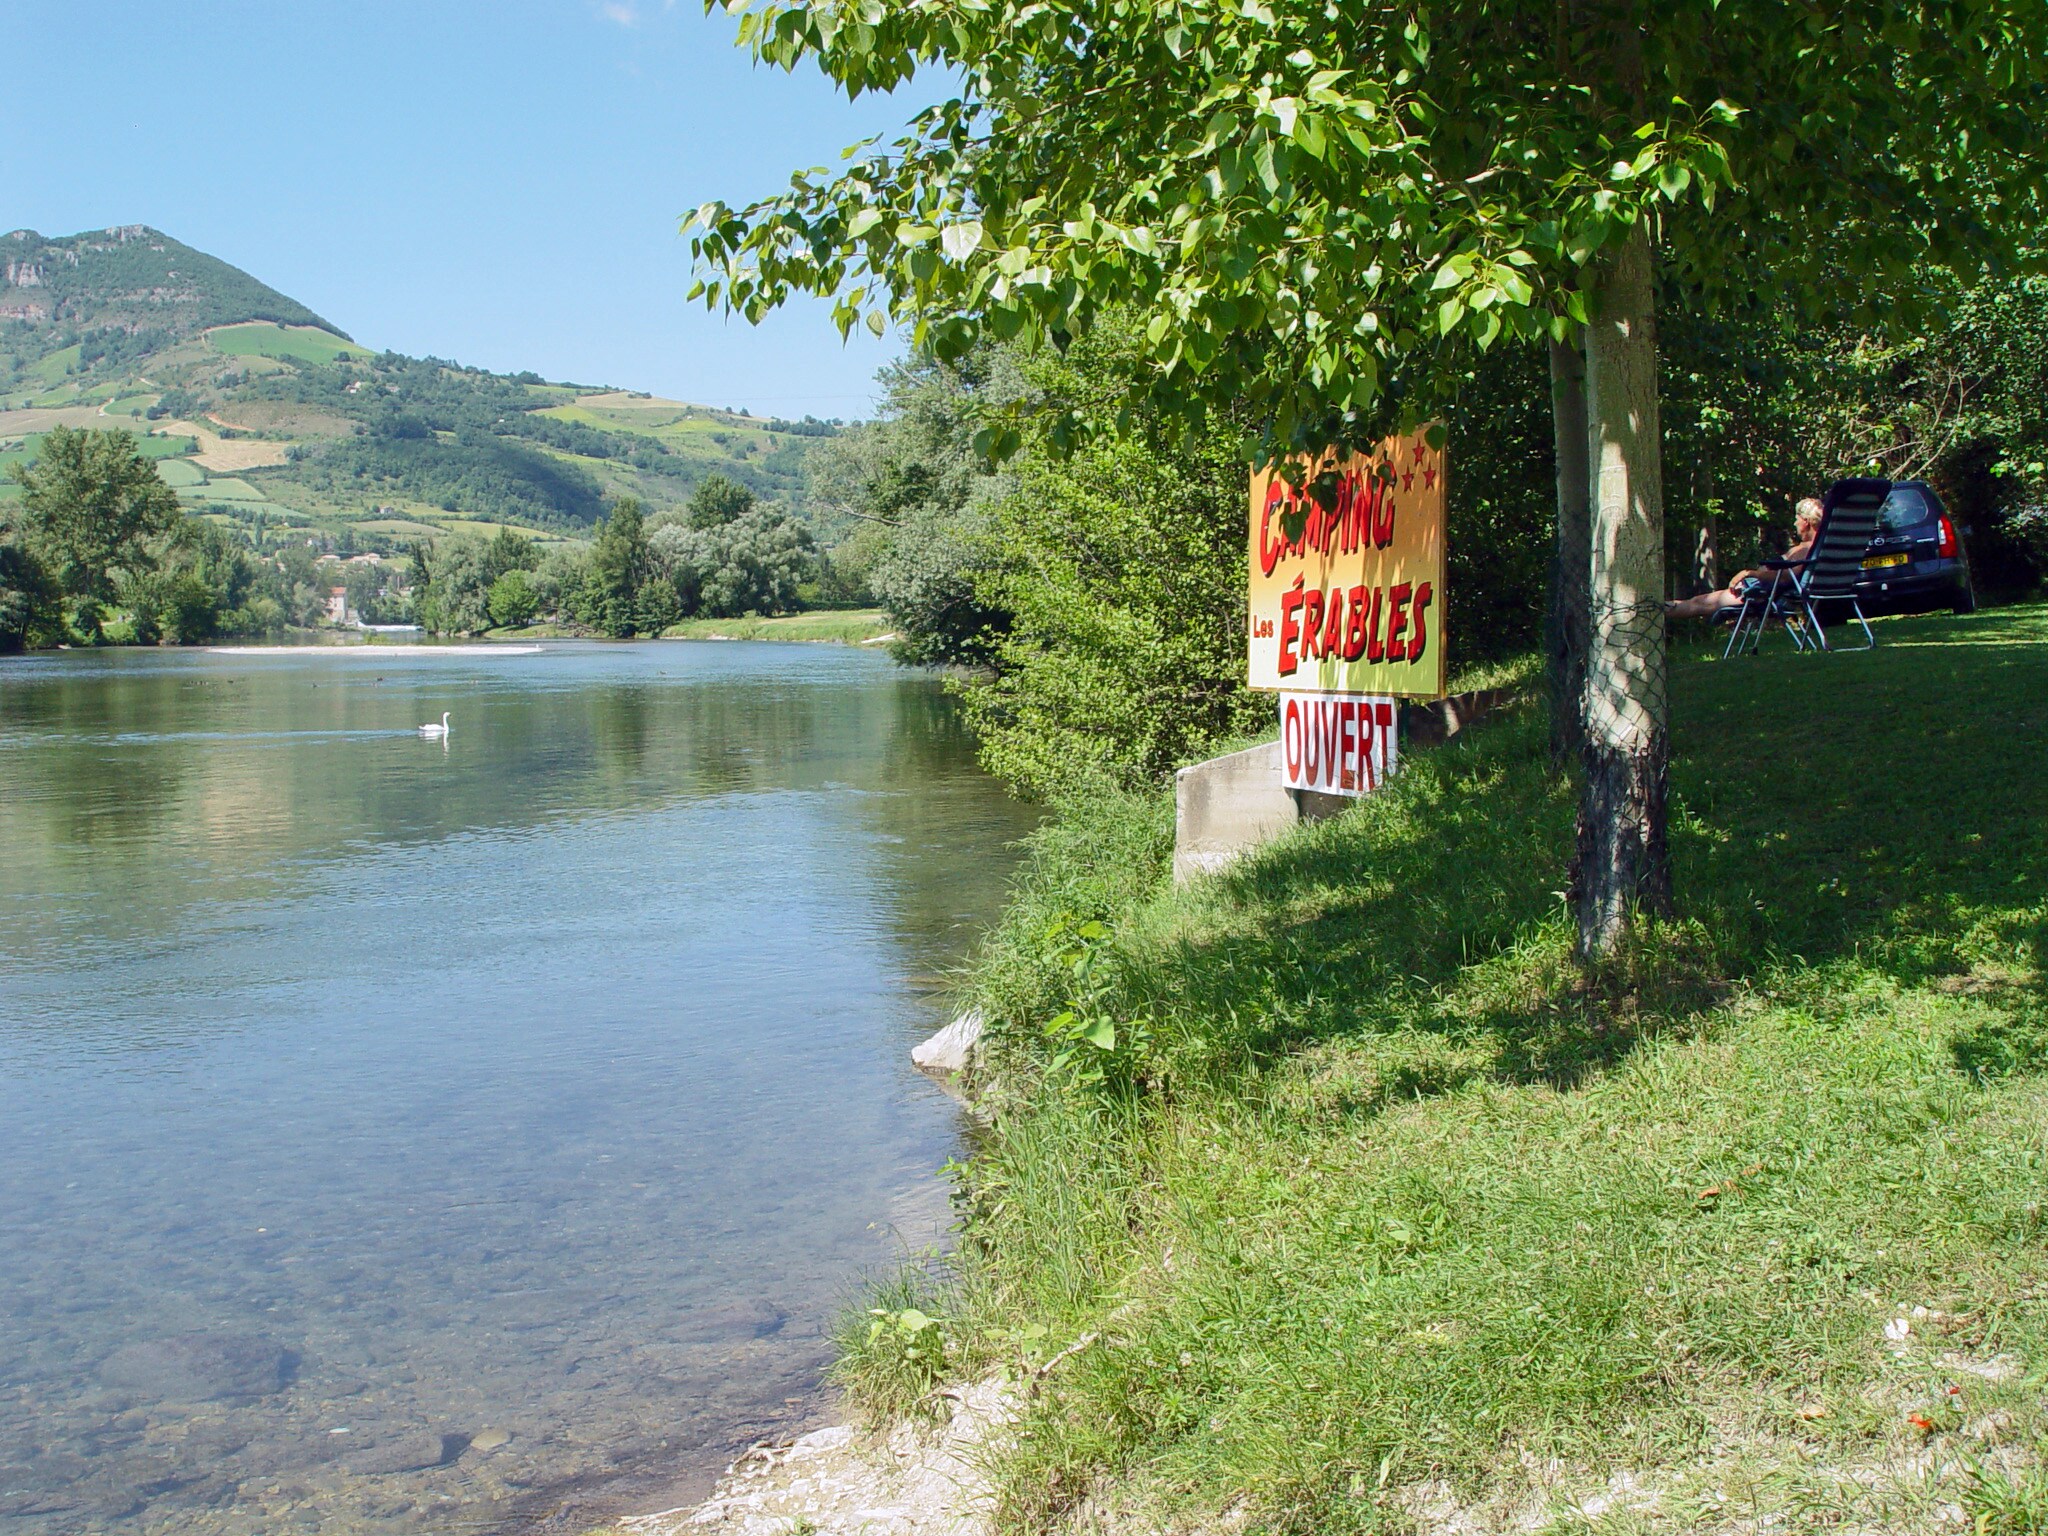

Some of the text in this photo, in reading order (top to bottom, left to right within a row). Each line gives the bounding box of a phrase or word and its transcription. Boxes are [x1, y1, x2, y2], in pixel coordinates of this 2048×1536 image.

[1253, 572, 1433, 678] Les ÉRABLES
[1285, 698, 1392, 792] OUVERT
